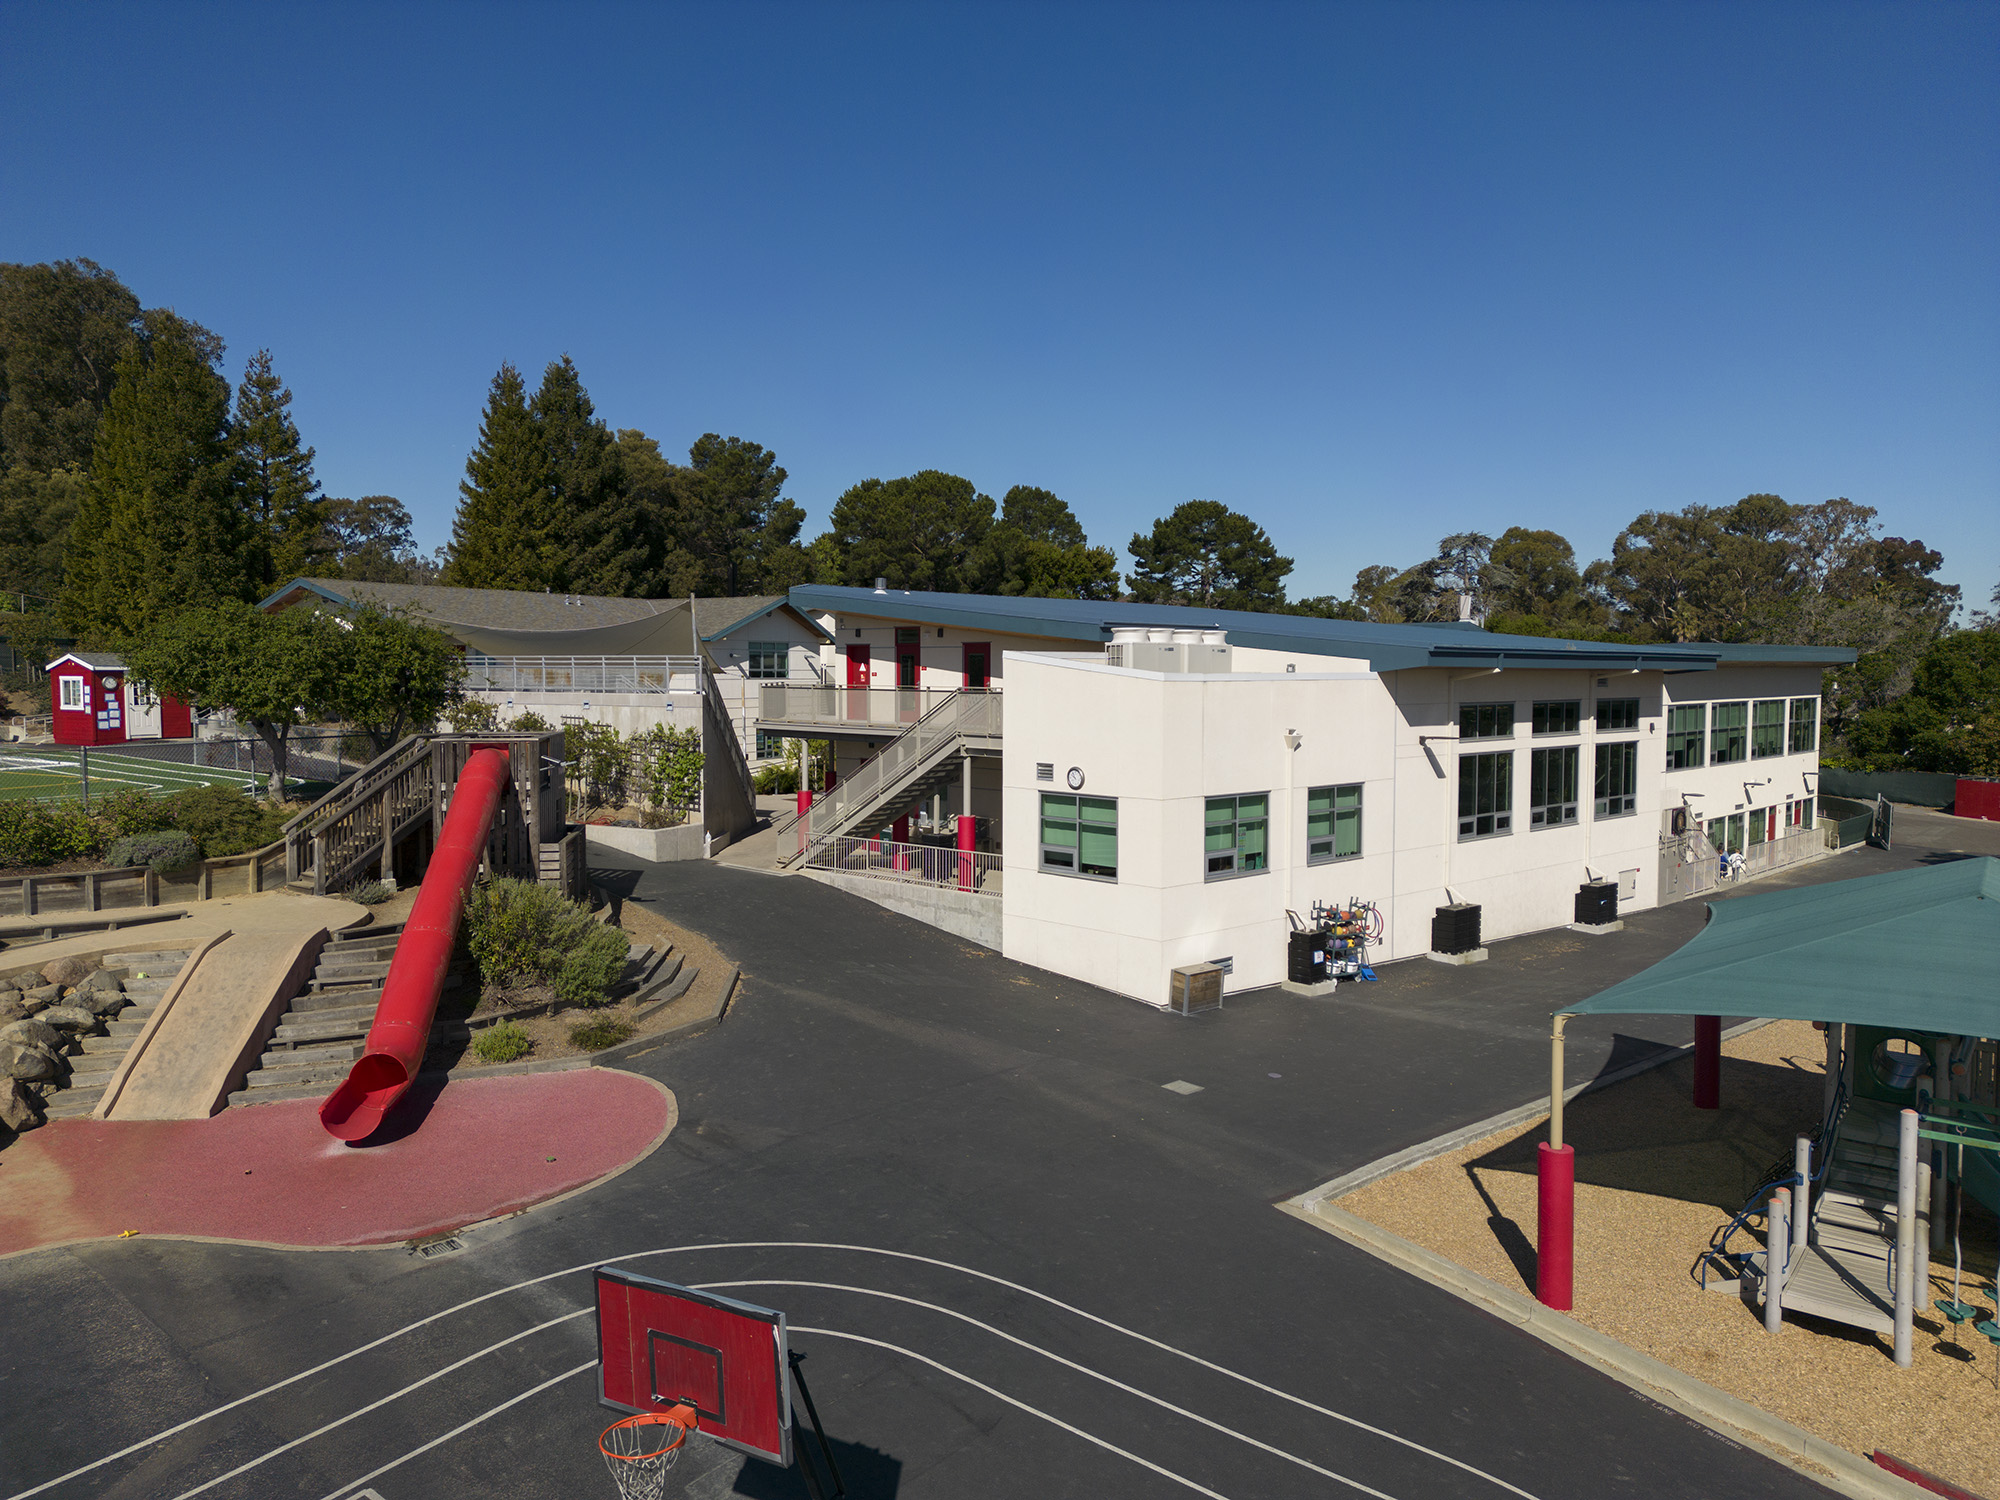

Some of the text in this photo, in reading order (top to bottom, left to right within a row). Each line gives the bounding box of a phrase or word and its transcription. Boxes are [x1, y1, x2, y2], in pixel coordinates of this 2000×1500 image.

[1628, 1390, 1650, 1403] FIRE
[1651, 1402, 1677, 1417] LANE
[1686, 1420, 1701, 1430] NO
[1702, 1428, 1743, 1450] PARKING
